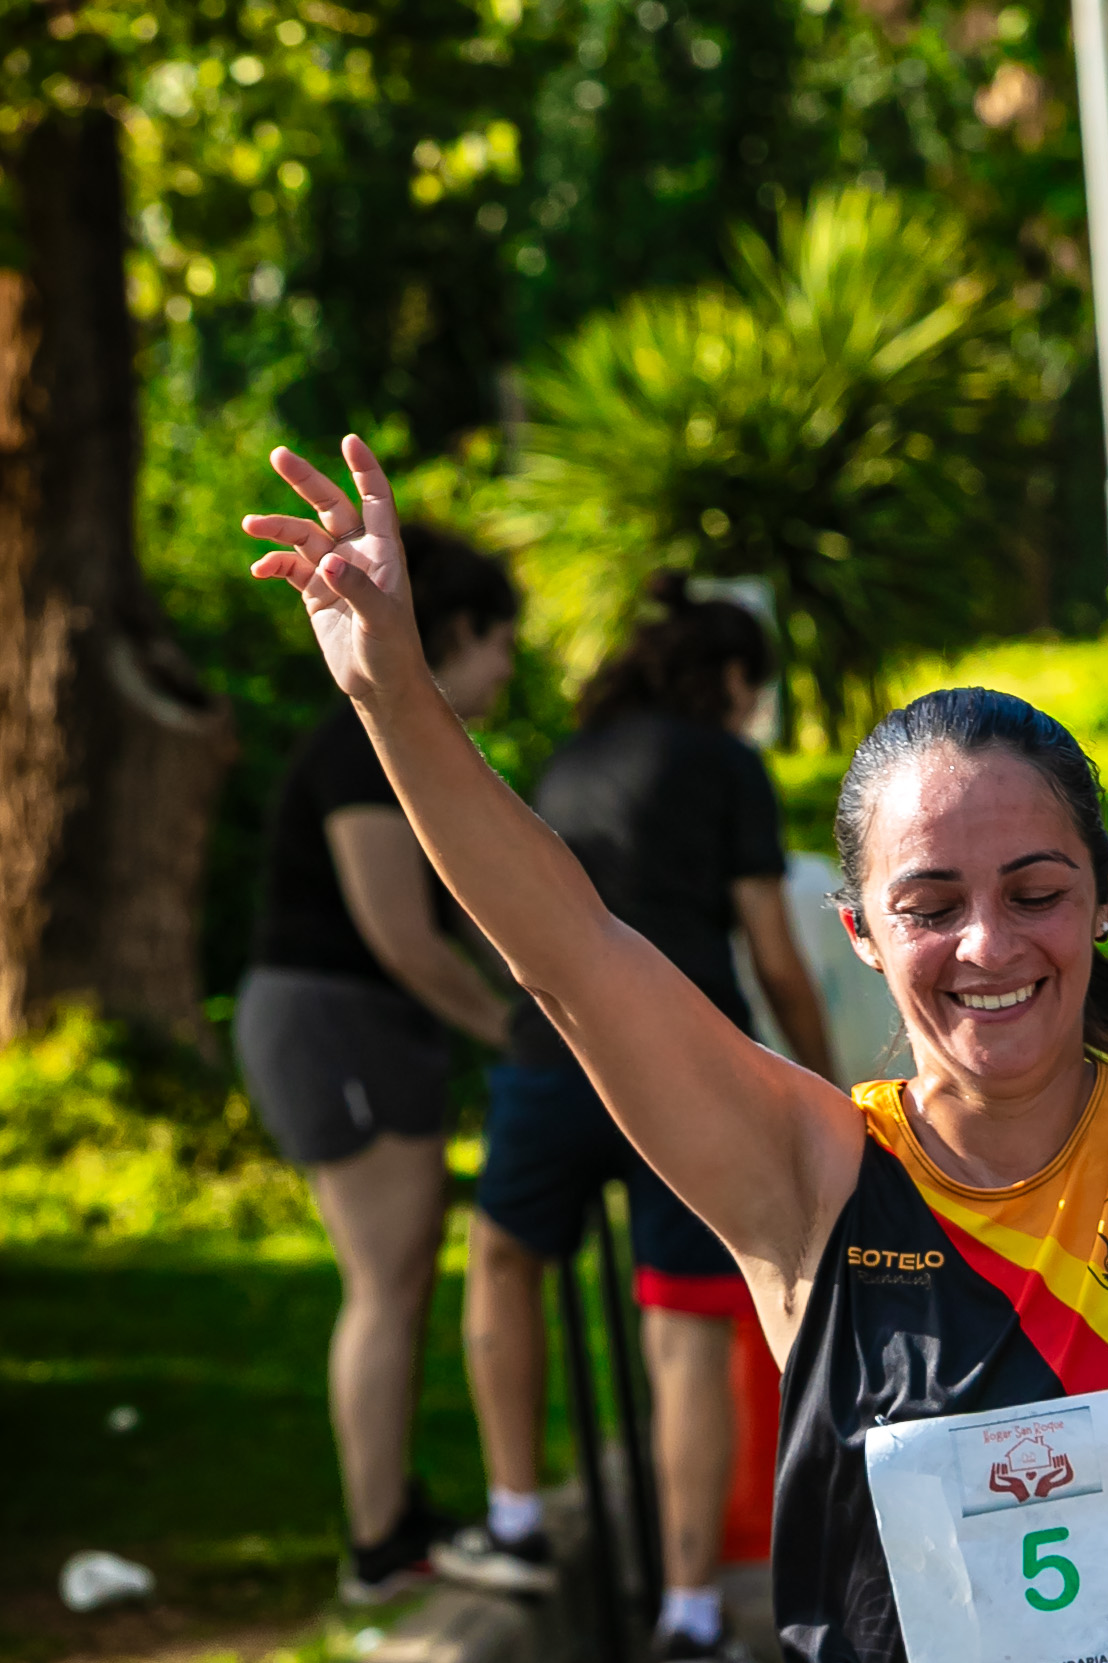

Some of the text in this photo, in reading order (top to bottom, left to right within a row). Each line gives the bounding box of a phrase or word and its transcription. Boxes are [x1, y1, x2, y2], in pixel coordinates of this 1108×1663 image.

[847, 1246, 944, 1270] SOTELO
[1014, 1425, 1032, 1438] San
[1033, 1421, 1064, 1434] Roque
[1023, 1526, 1080, 1612] 5
